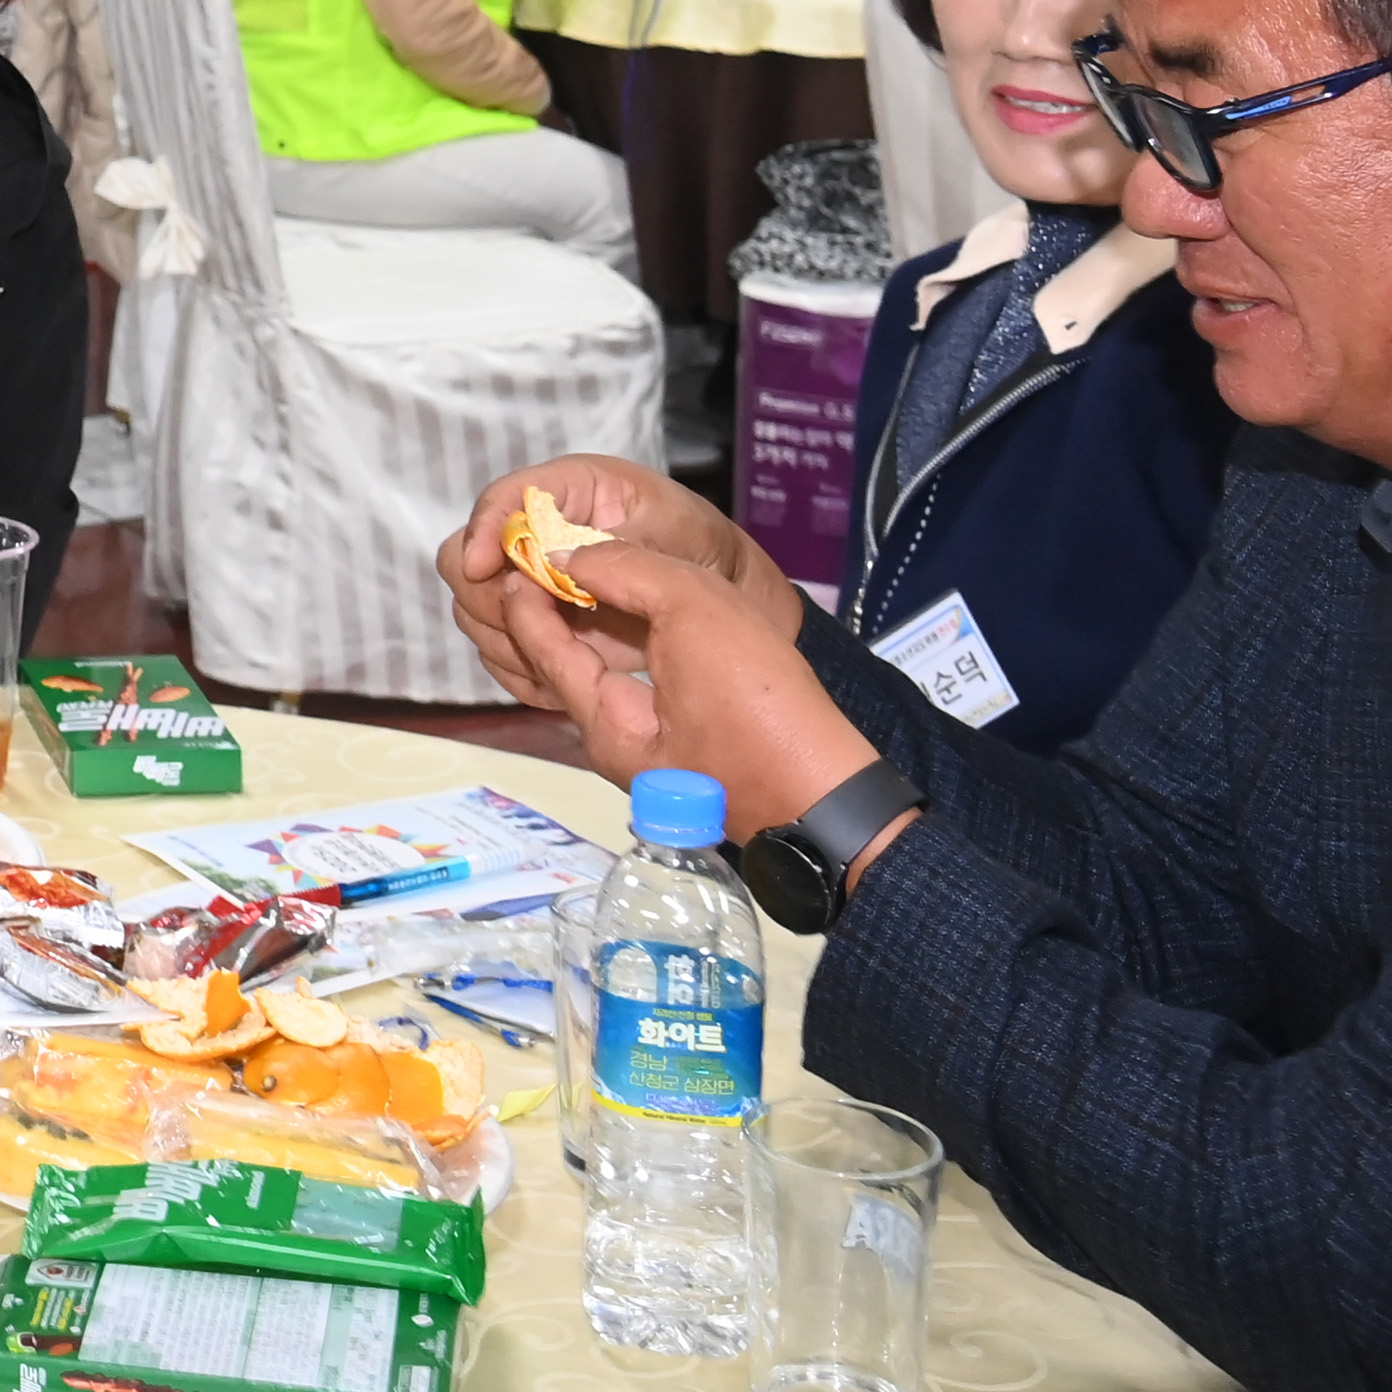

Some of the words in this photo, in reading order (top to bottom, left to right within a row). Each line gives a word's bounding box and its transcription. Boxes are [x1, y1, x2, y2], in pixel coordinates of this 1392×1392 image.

[920, 651, 988, 706] 순덕
[629, 1048, 668, 1072] 경남
[628, 1070, 679, 1091] 산청군
[684, 1076, 735, 1096] 삼장면
